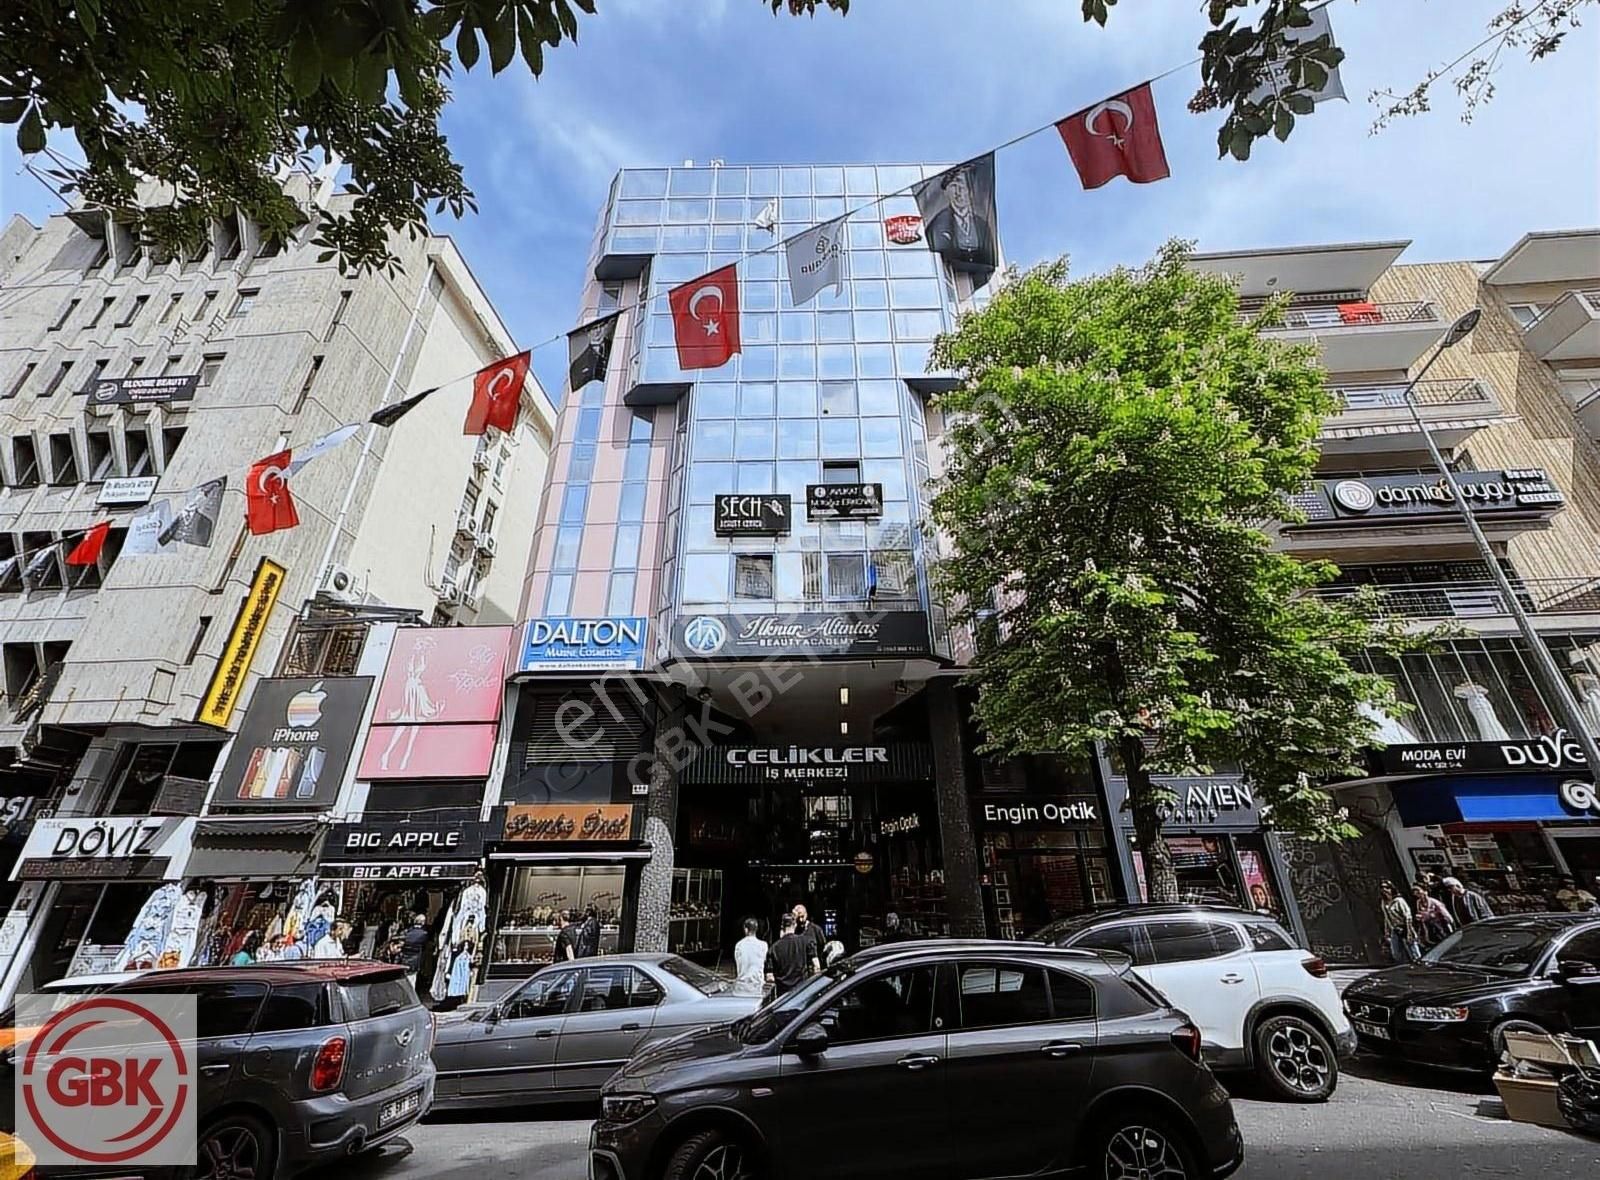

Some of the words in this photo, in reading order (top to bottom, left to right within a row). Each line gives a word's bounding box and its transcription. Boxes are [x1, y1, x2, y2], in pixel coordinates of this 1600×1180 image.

[720, 497, 762, 518] SECH
[531, 620, 641, 645] DALTON
[759, 638, 800, 647] BEAUTY
[272, 728, 320, 742] iPhone
[726, 744, 888, 768] ÇELİKLER
[1401, 750, 1442, 761] MODA
[1446, 745, 1466, 760] EVİ
[784, 765, 848, 778] MERKEZİ
[984, 803, 1039, 824] Engin
[1043, 801, 1097, 824] Optik
[52, 819, 162, 856] DÖVİZ
[347, 832, 381, 847] BIG
[388, 832, 460, 847] APPLE
[352, 867, 381, 878] BIG
[386, 866, 442, 878] APPLE
